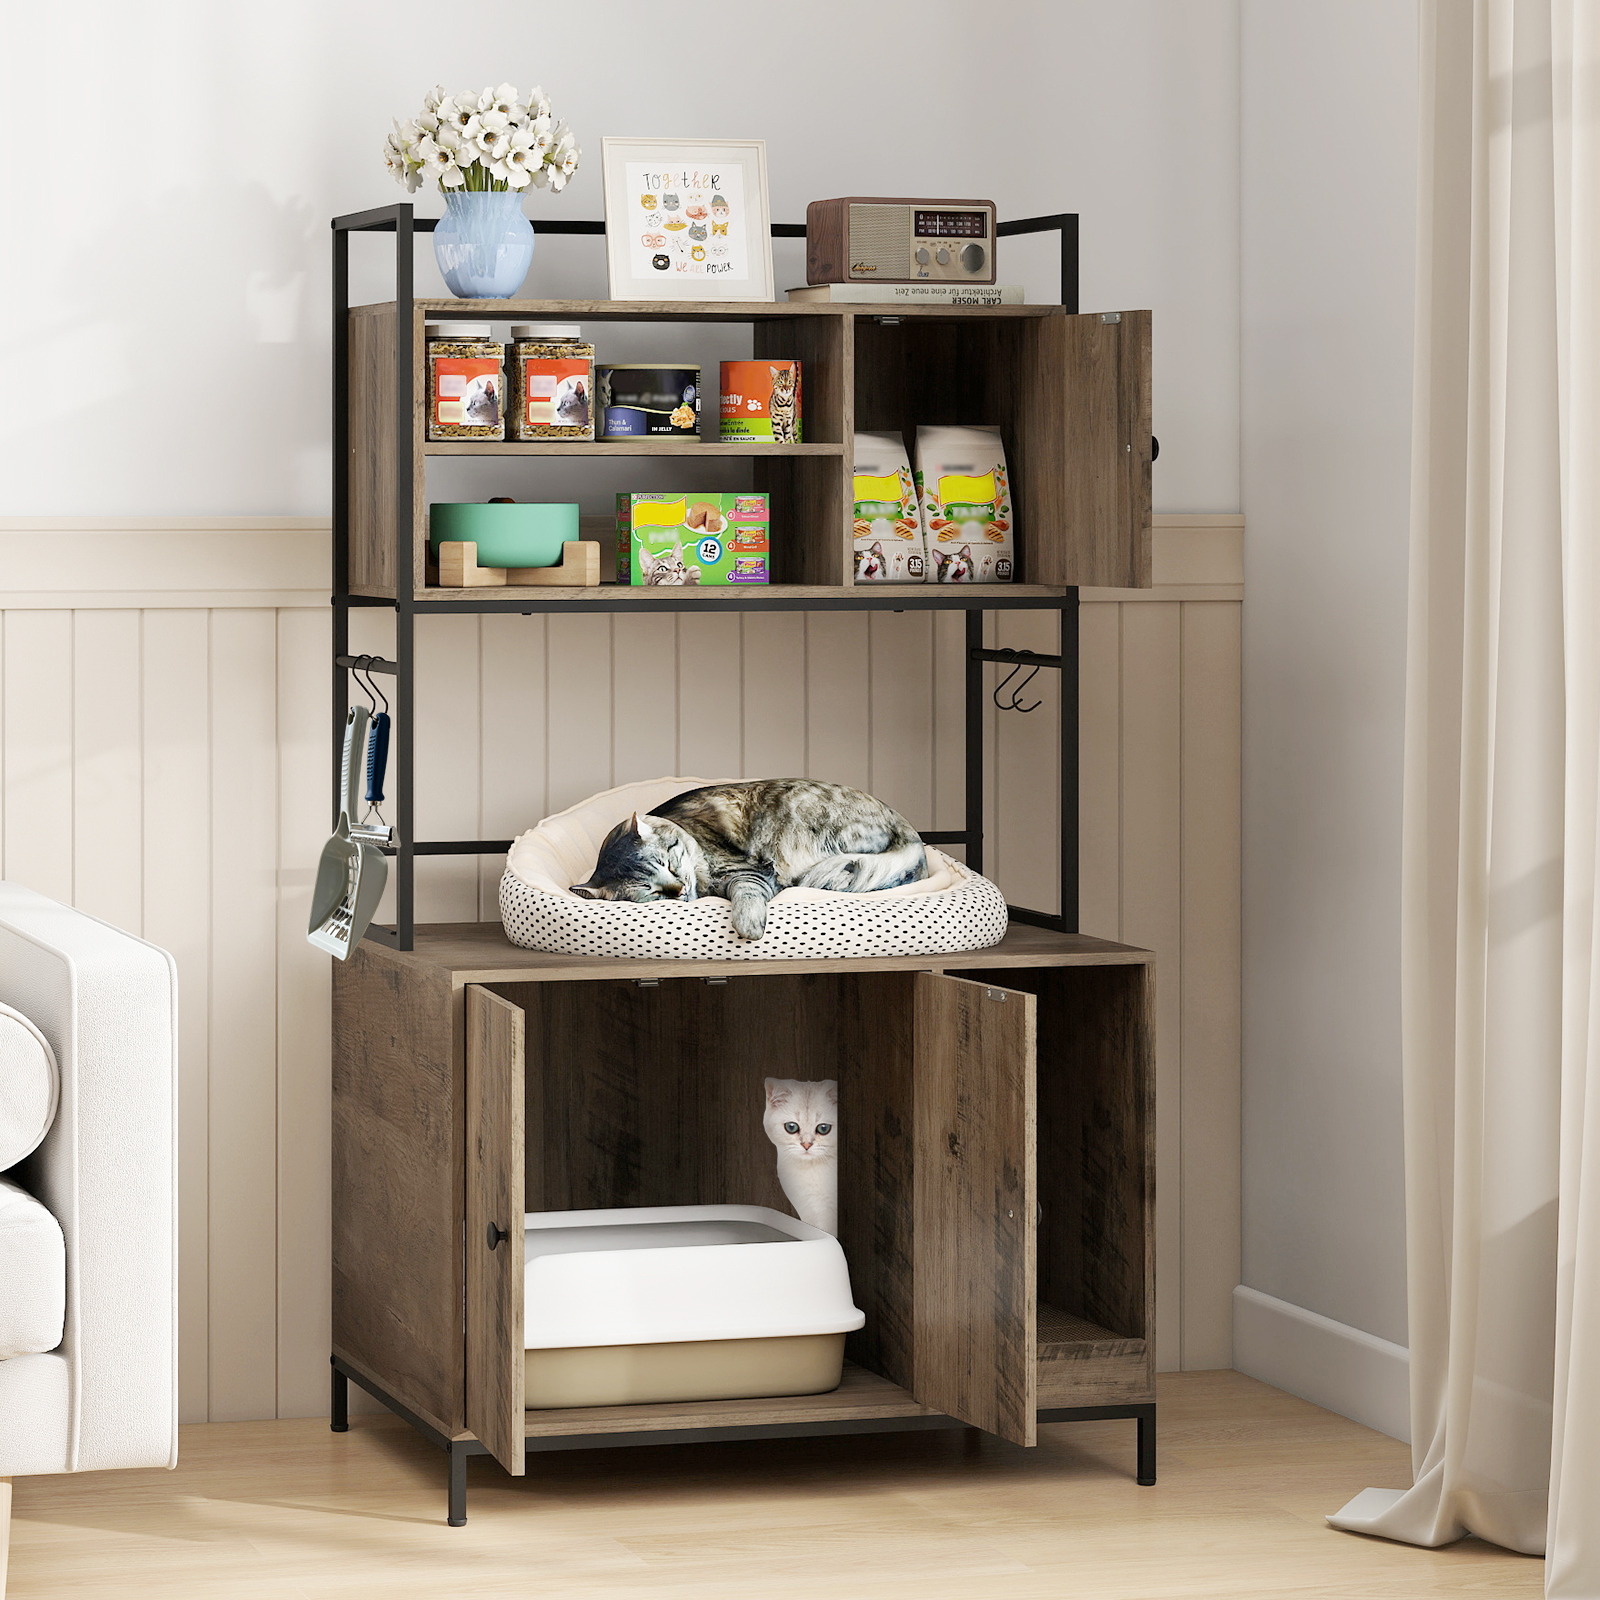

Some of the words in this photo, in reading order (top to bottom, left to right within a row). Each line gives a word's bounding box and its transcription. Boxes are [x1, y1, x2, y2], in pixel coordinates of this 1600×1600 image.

[895, 288, 909, 297] Zeit
[931, 288, 947, 297] eine
[948, 288, 959, 297] für
[961, 288, 1003, 297] Architektur
[952, 297, 979, 305] MOSER
[982, 297, 1002, 305] CARL
[703, 543, 717, 554] 12
